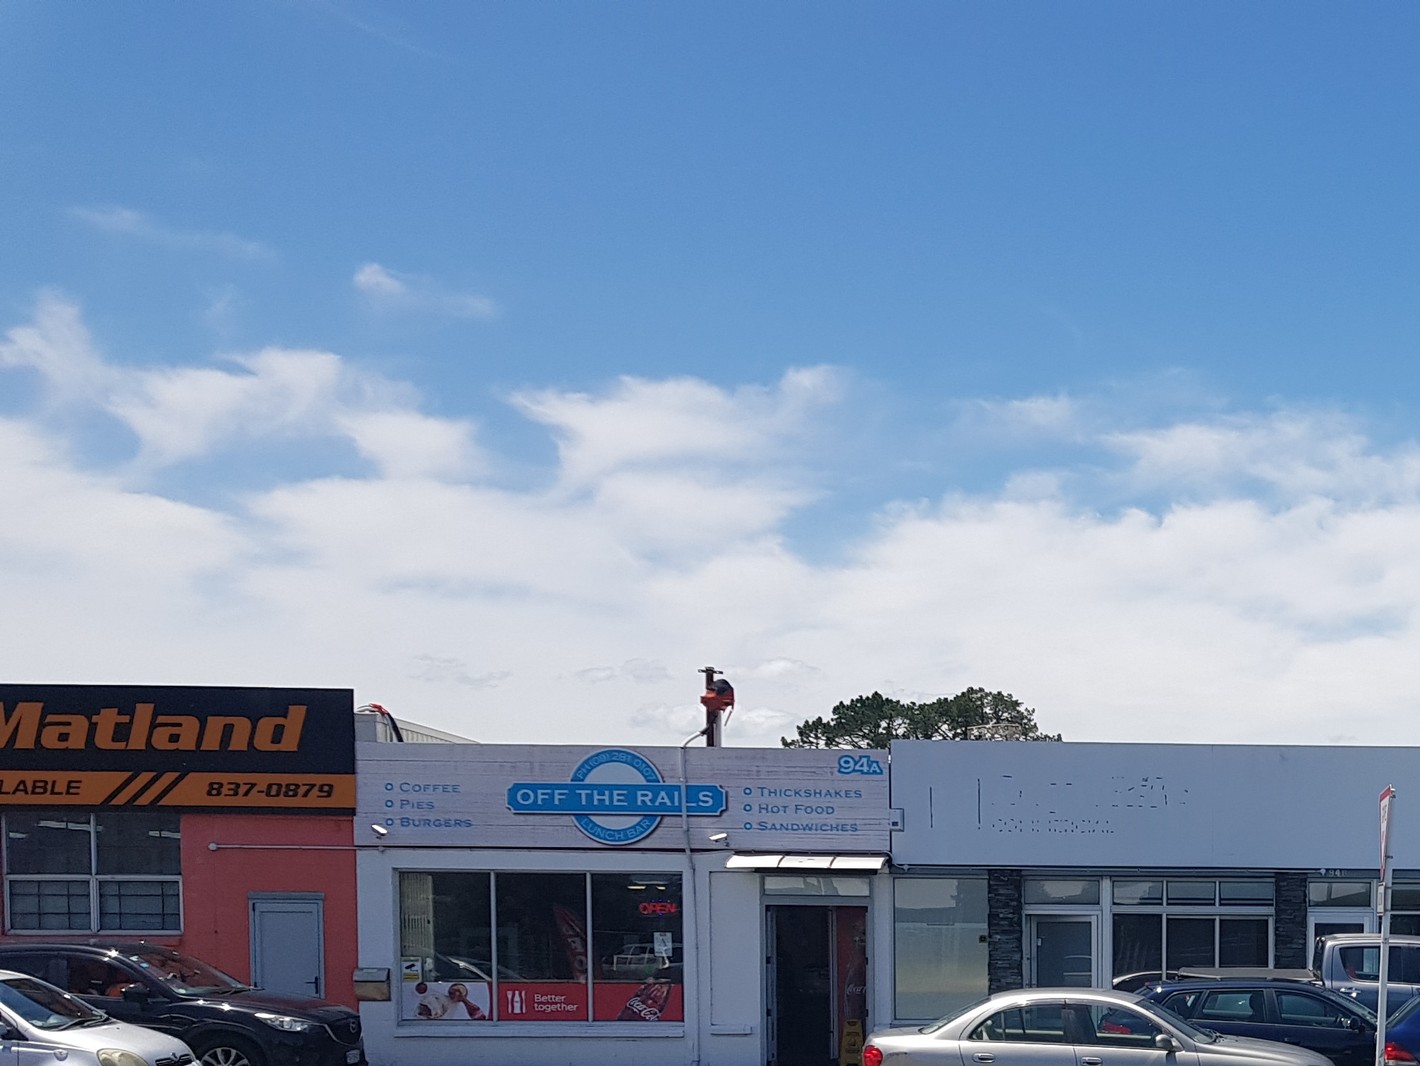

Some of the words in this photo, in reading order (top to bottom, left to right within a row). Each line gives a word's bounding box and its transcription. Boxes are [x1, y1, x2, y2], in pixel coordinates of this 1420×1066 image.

[0, 701, 308, 752] Matland
[838, 755, 884, 775] 94A
[206, 781, 335, 799] 837-0879
[516, 789, 569, 805] OFF
[575, 789, 628, 806] THE
[580, 818, 624, 841] LUNCH
[626, 818, 651, 838] BAR
[639, 902, 678, 915] OPEN
[534, 994, 566, 1002] Better
[534, 1003, 579, 1013] together
